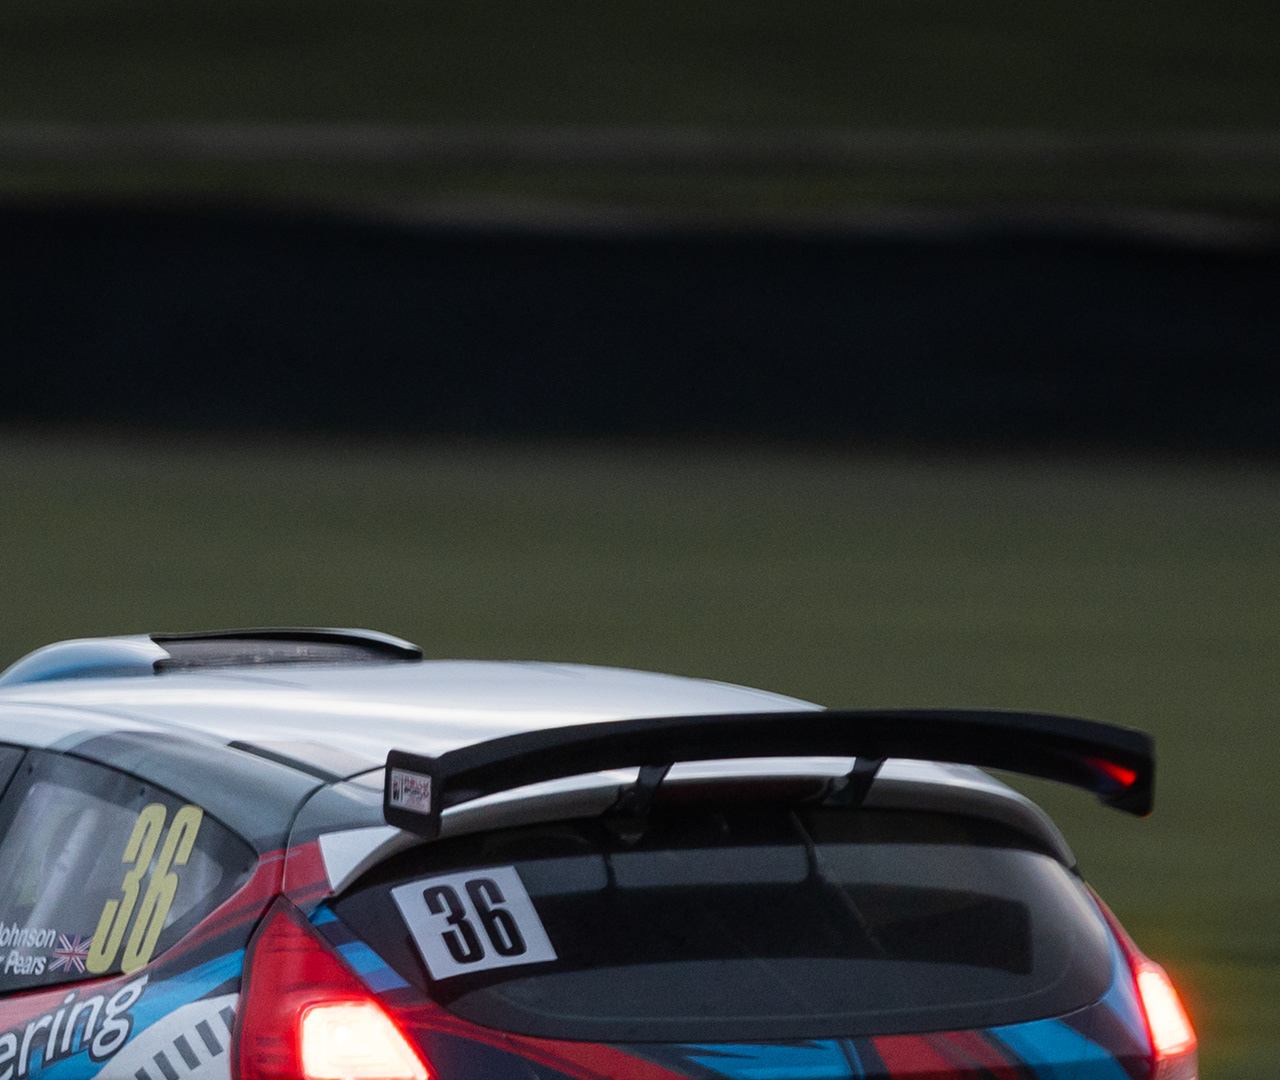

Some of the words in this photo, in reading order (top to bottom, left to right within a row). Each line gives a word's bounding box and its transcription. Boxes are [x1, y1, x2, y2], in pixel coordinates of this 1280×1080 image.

[86, 803, 204, 975] 36
[422, 877, 528, 965] 36
[4, 949, 48, 976] Pears
